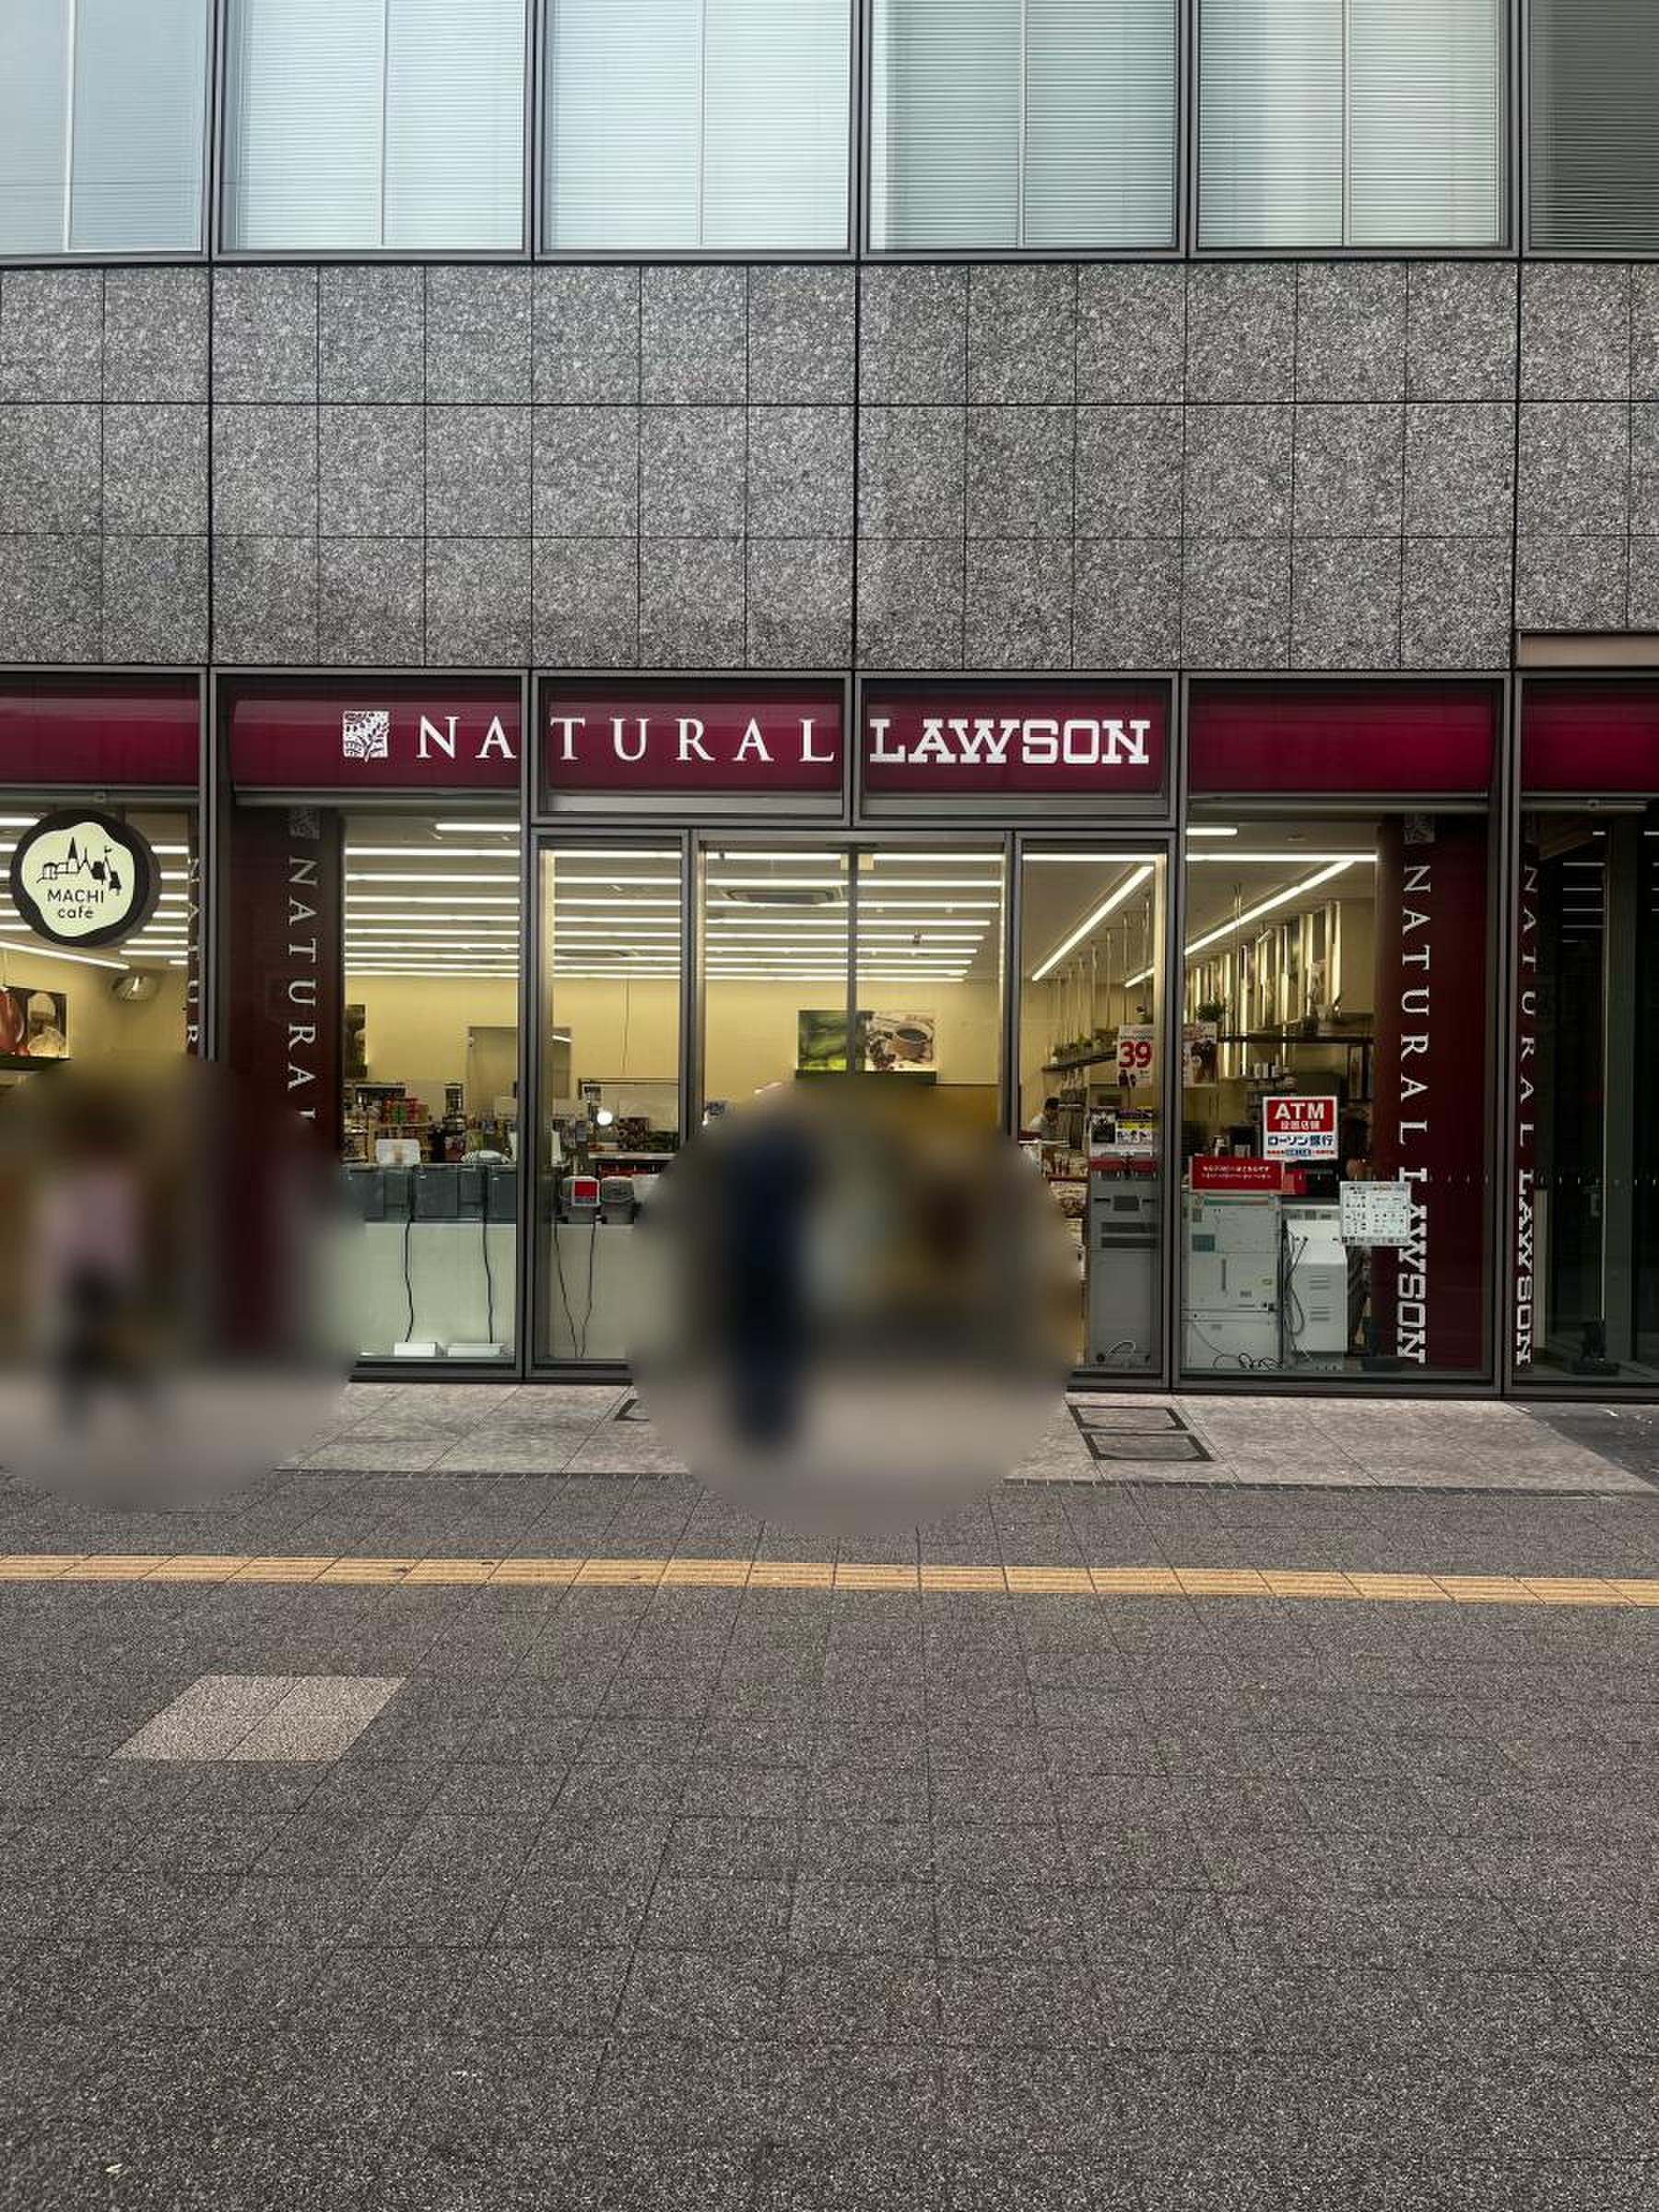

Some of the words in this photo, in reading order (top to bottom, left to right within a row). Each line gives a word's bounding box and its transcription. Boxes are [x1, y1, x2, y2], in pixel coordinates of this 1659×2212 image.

[416, 715, 835, 762] NATURAL
[869, 719, 1151, 764] LAWSON
[47, 888, 104, 903] MACHI
[1398, 865, 1431, 1146] NATURAL
[1520, 865, 1537, 1147] NATURAL
[1274, 1102, 1325, 1120] ATM
[1516, 1169, 1535, 1366] LAWSON
